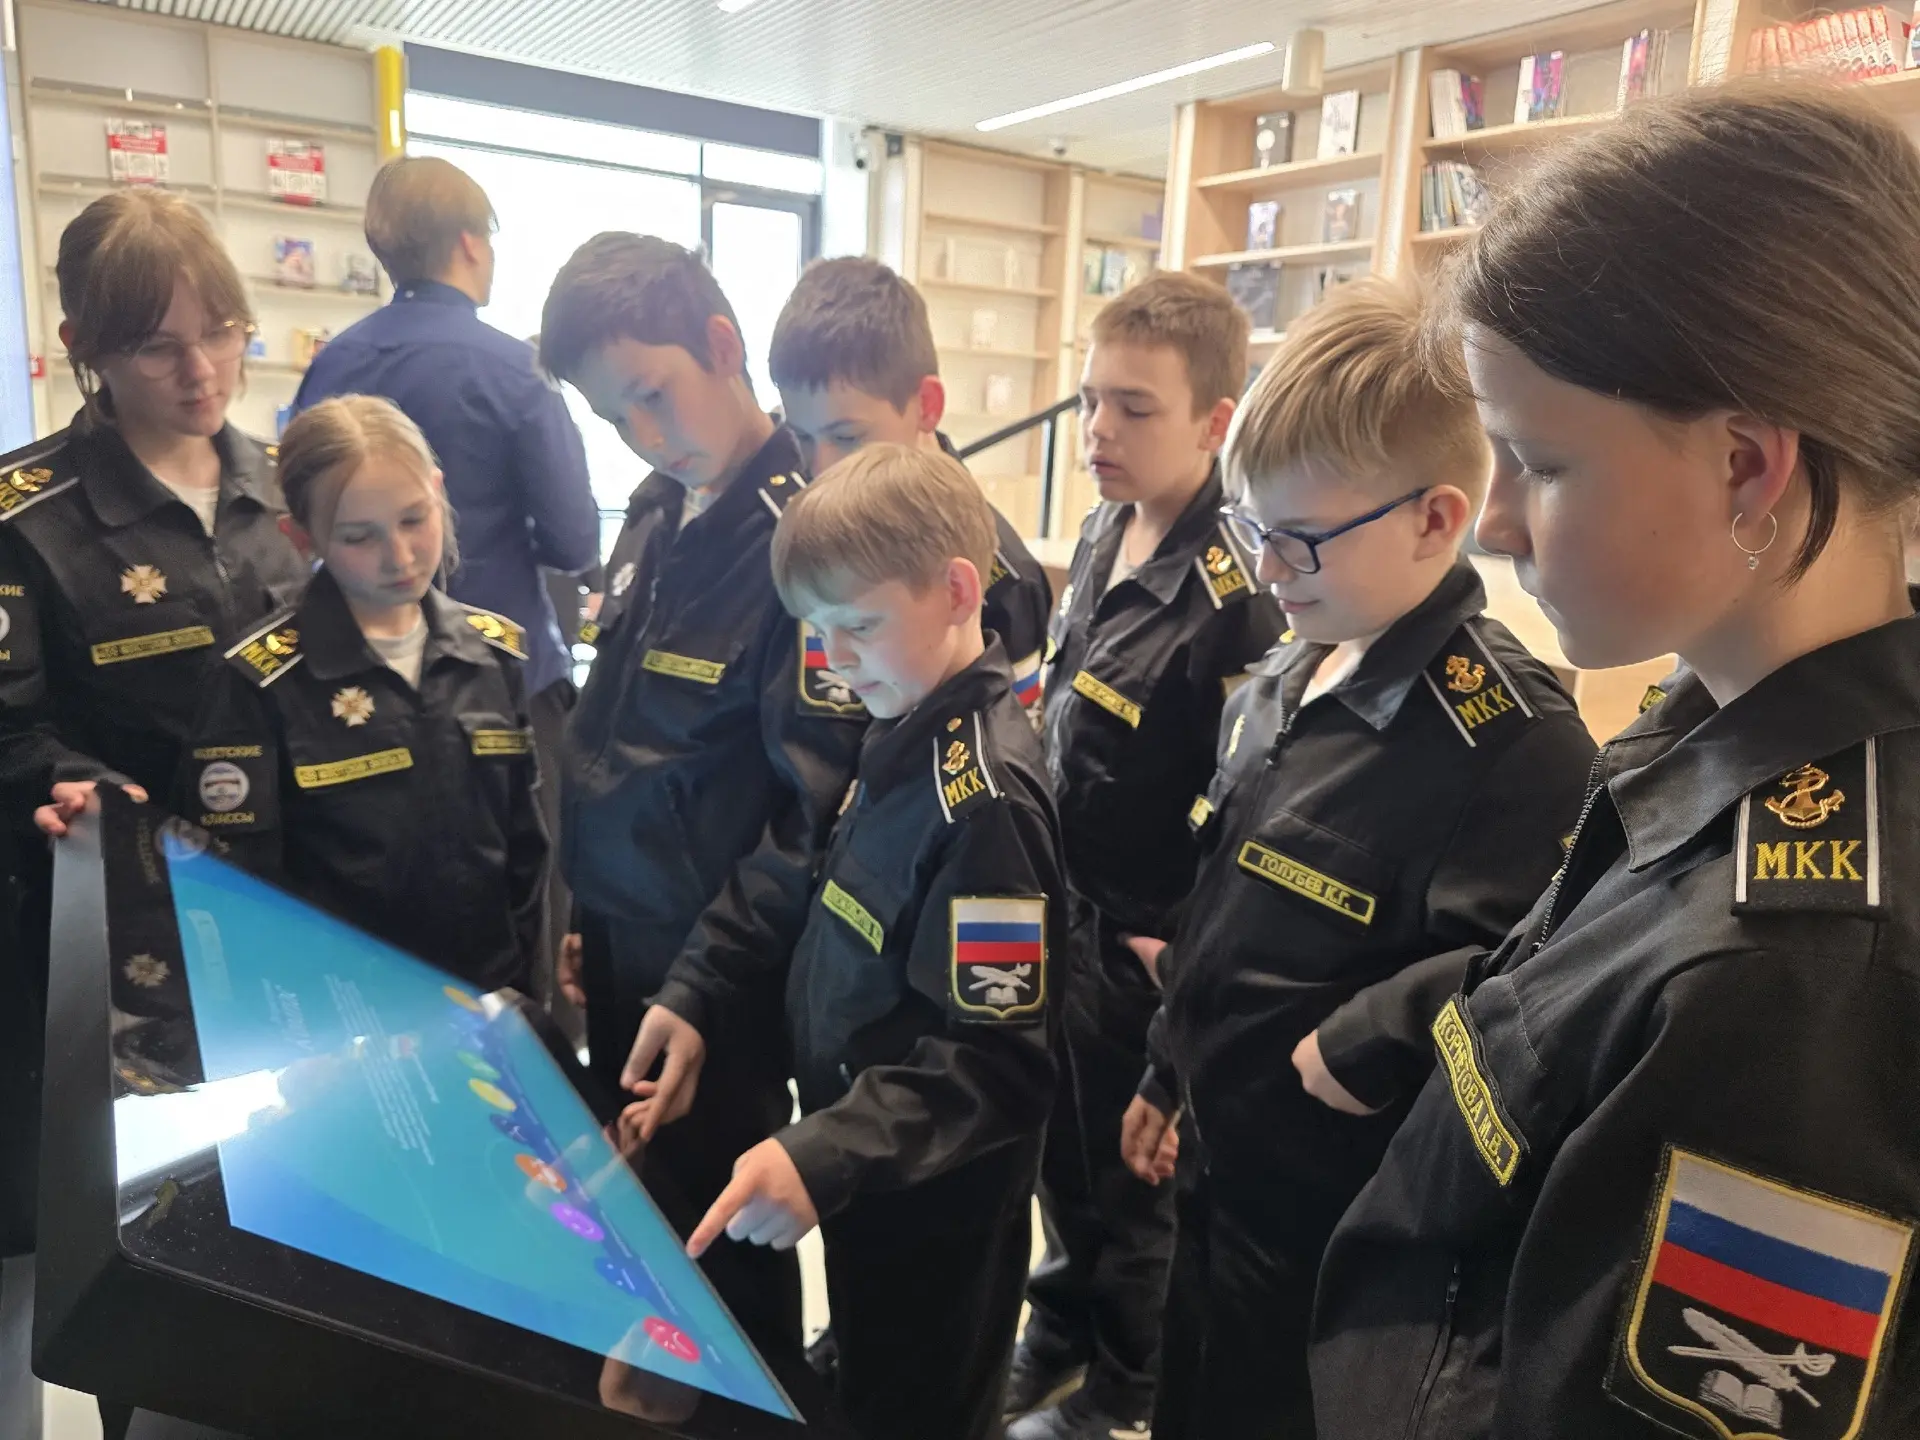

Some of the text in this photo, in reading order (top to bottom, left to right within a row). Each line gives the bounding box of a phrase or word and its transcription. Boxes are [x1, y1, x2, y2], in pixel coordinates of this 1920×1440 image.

[1455, 682, 1516, 729] МКК
[943, 766, 987, 808] МКК
[1259, 853, 1325, 894] ГОЛУБЕВ
[1753, 840, 1863, 880] МКК
